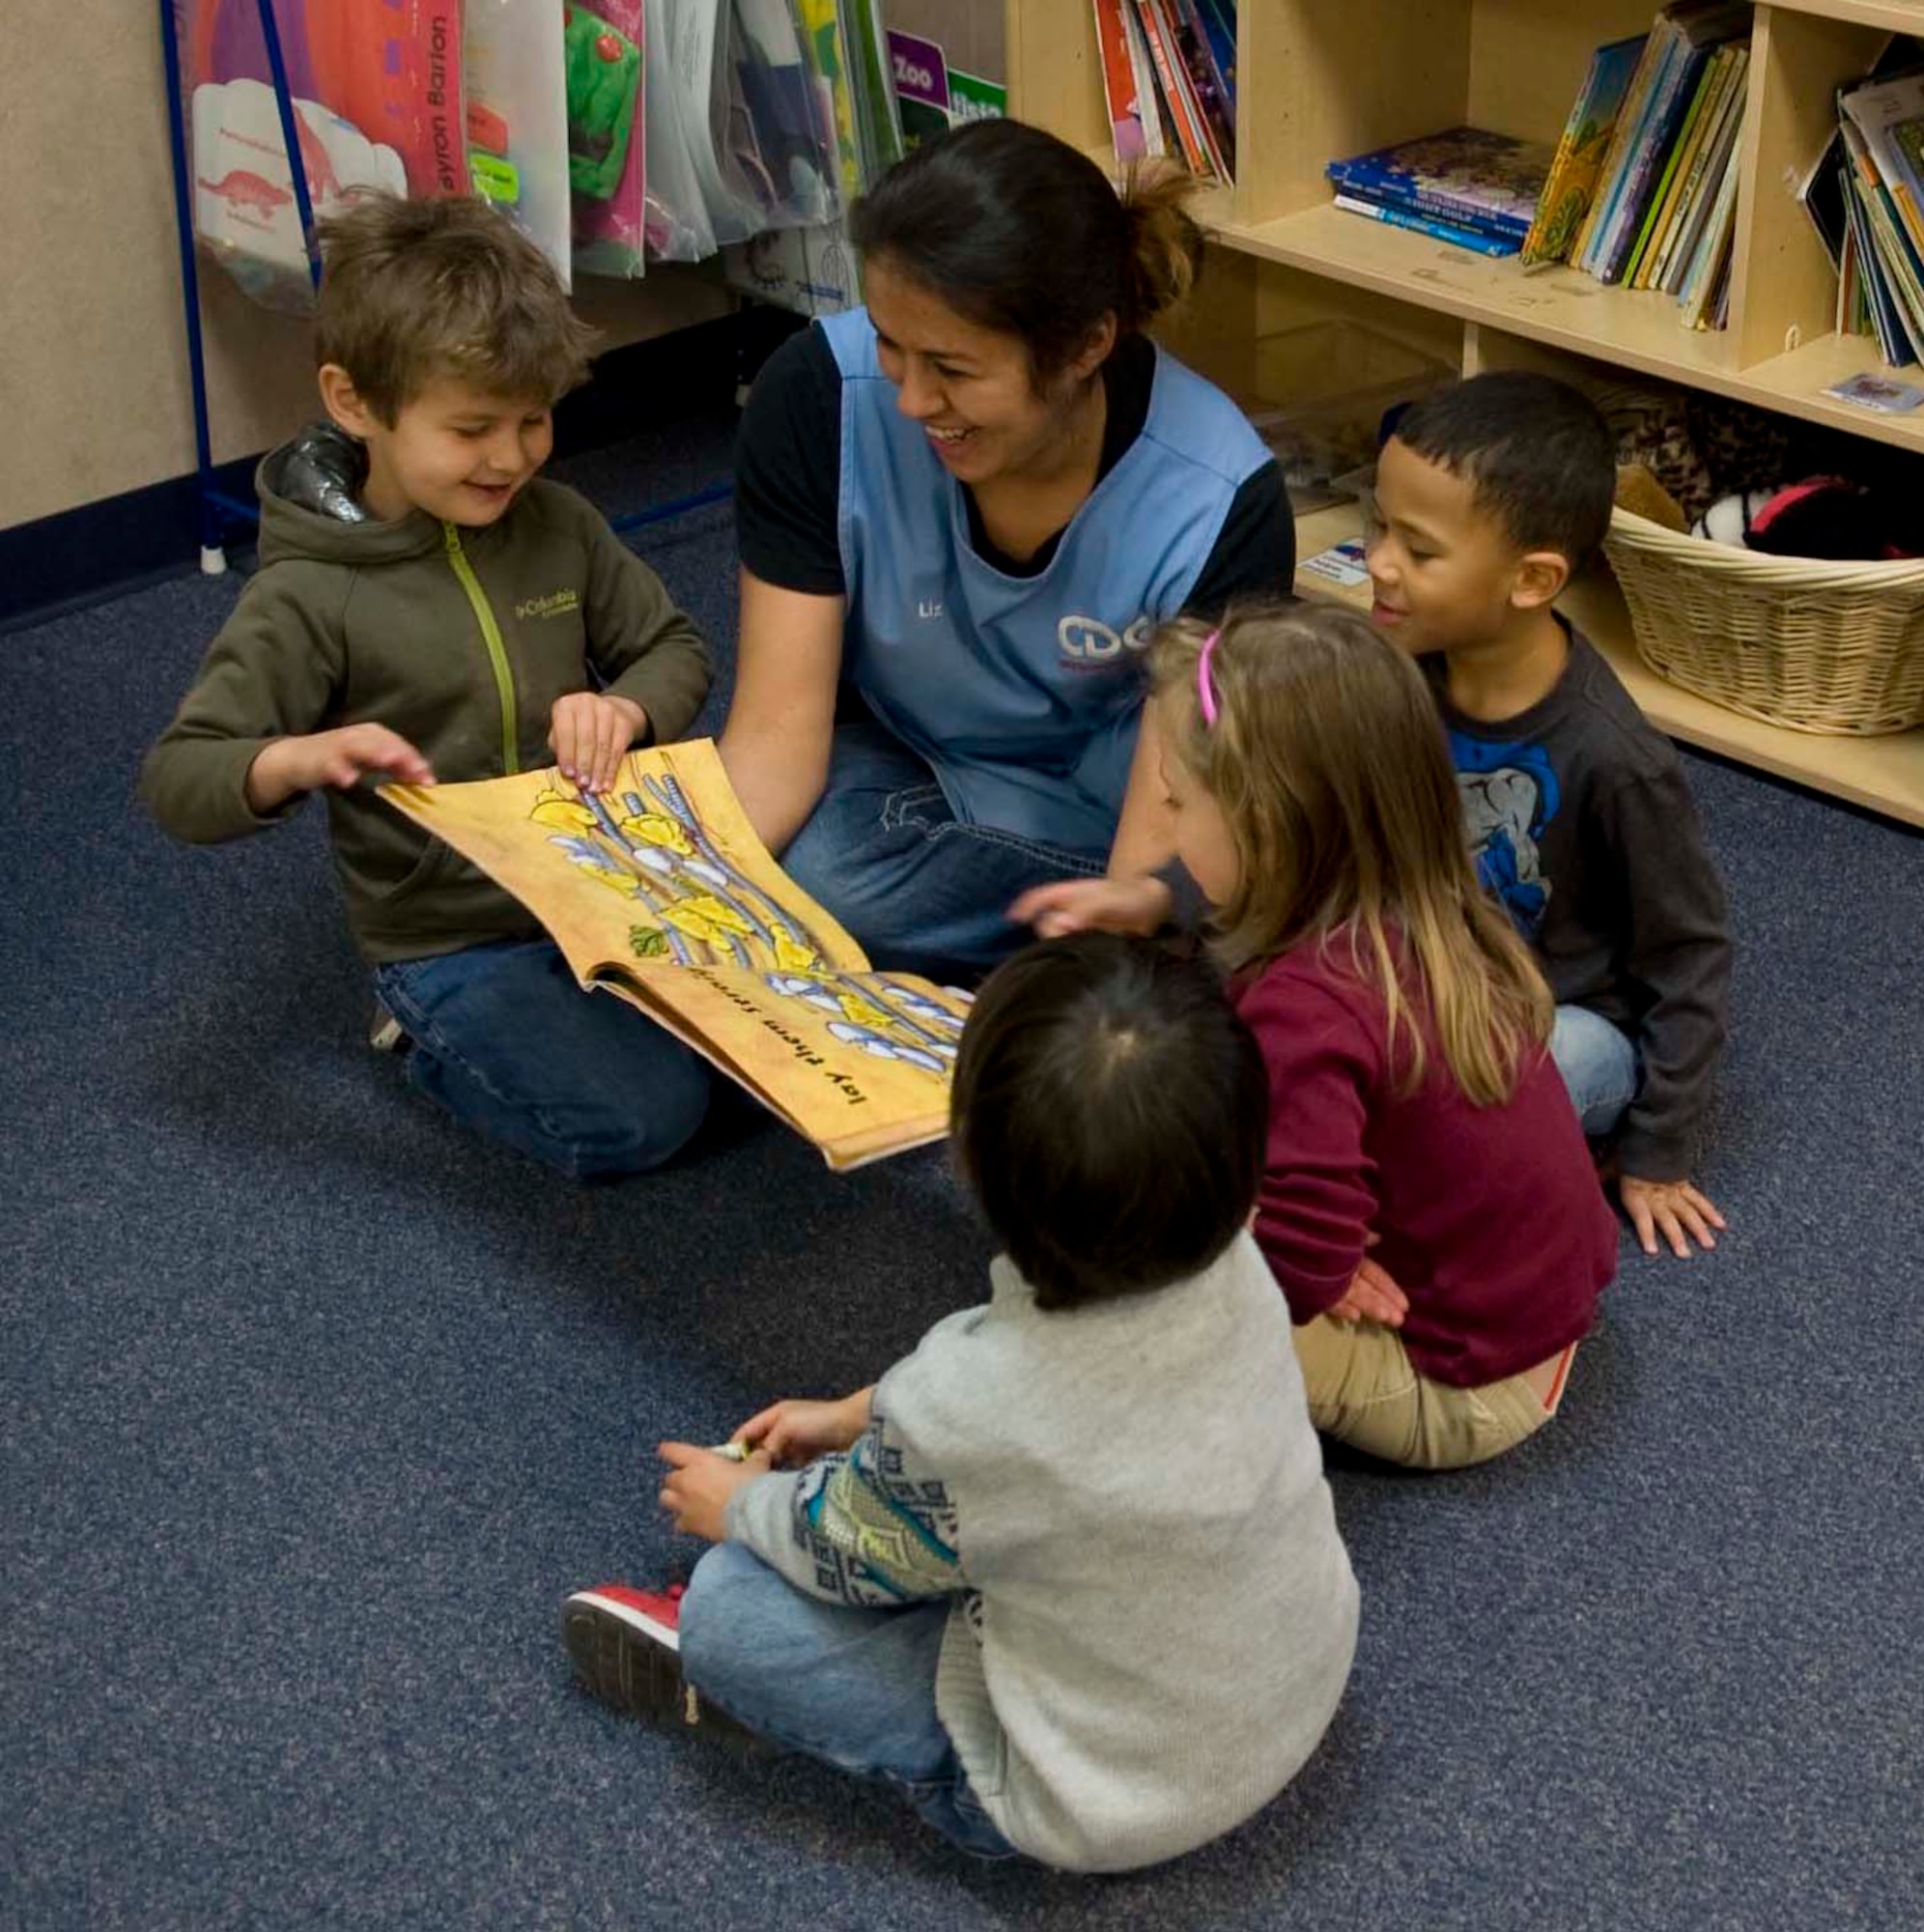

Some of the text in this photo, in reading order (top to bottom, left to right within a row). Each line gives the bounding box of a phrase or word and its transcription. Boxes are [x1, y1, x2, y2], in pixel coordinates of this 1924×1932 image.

[892, 55, 932, 91] Zoo
[919, 598, 944, 618] Liz
[762, 1020, 825, 1065] them
[824, 1071, 867, 1105] lay
